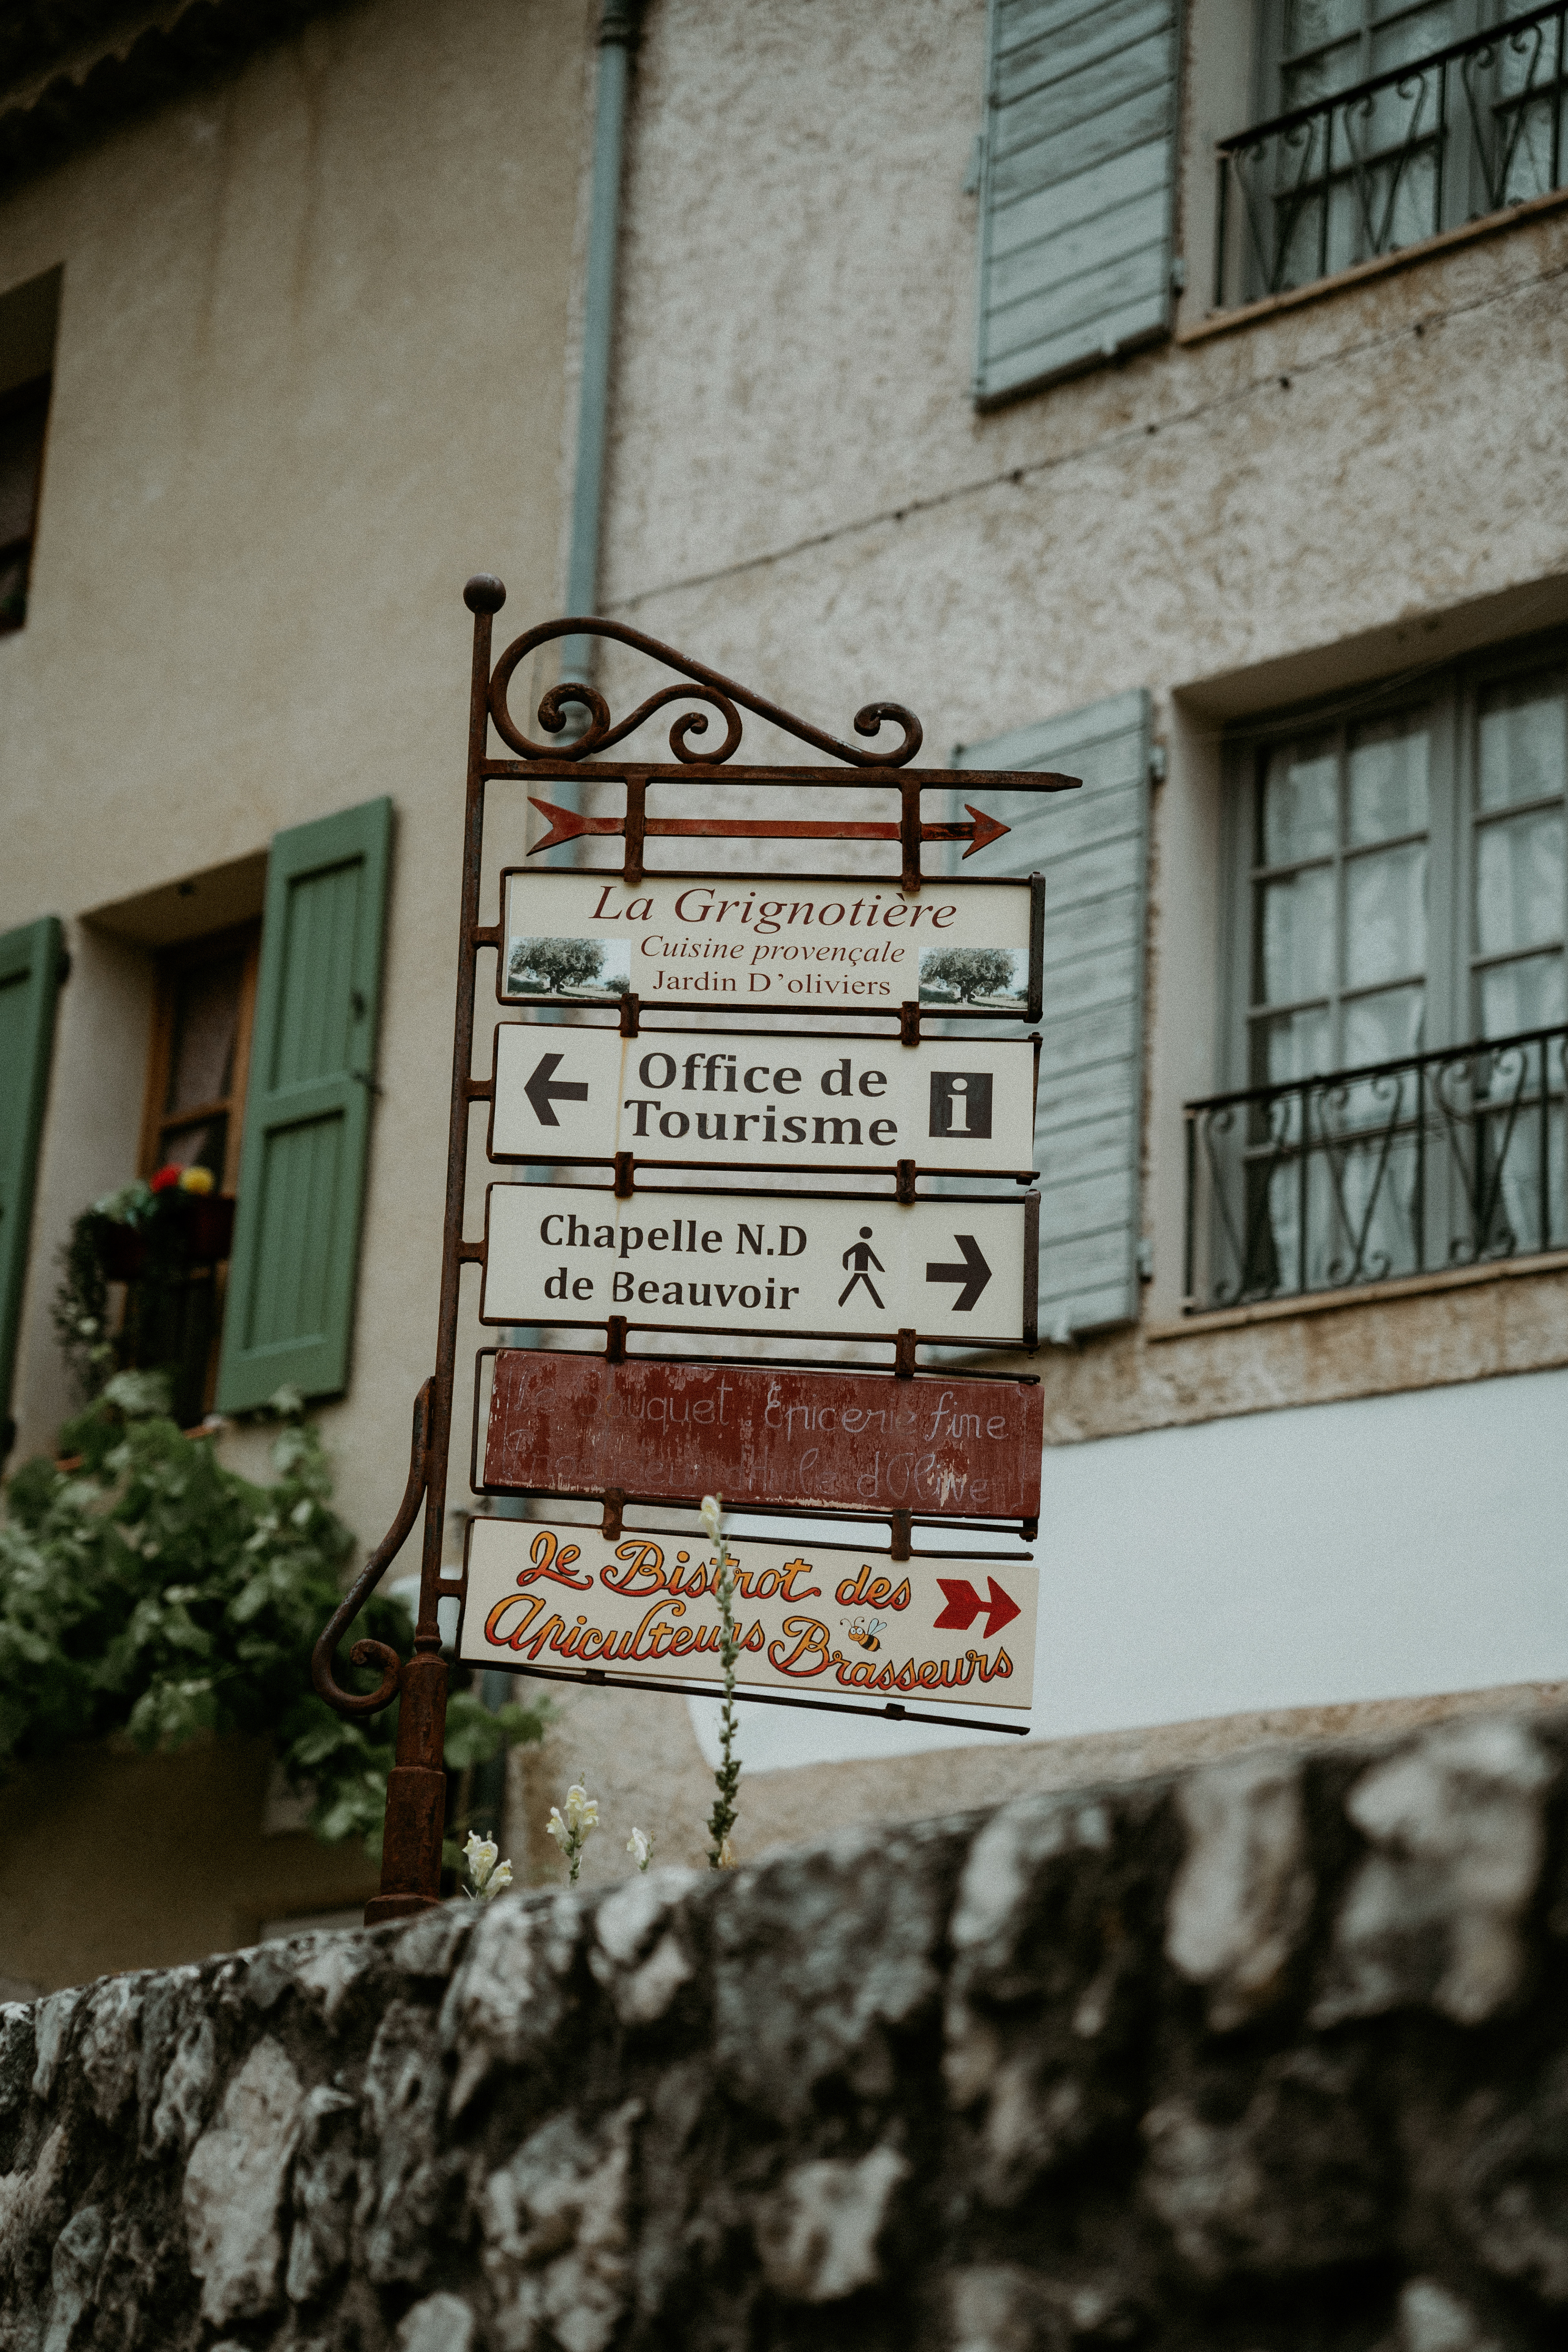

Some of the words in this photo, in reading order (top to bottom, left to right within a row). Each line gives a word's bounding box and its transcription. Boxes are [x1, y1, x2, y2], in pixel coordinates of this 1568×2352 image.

[589, 886, 653, 921] La
[675, 888, 957, 934] Grignotière
[641, 935, 744, 959] Cuisine
[750, 941, 905, 967] provençale
[653, 970, 736, 991] Jardin
[639, 1052, 802, 1094] Office
[821, 1058, 887, 1097] de
[624, 1099, 898, 1146] Tourisme
[540, 1214, 722, 1258] Chapelle
[736, 1223, 807, 1256] N.D
[544, 1267, 594, 1301] de
[612, 1271, 799, 1310] Beauvoir
[924, 1391, 1009, 1442] fine
[516, 1531, 593, 1590] Le
[600, 1539, 822, 1603] Bistrot
[835, 1564, 911, 1611] des
[767, 1616, 1014, 1691] Brasseurs
